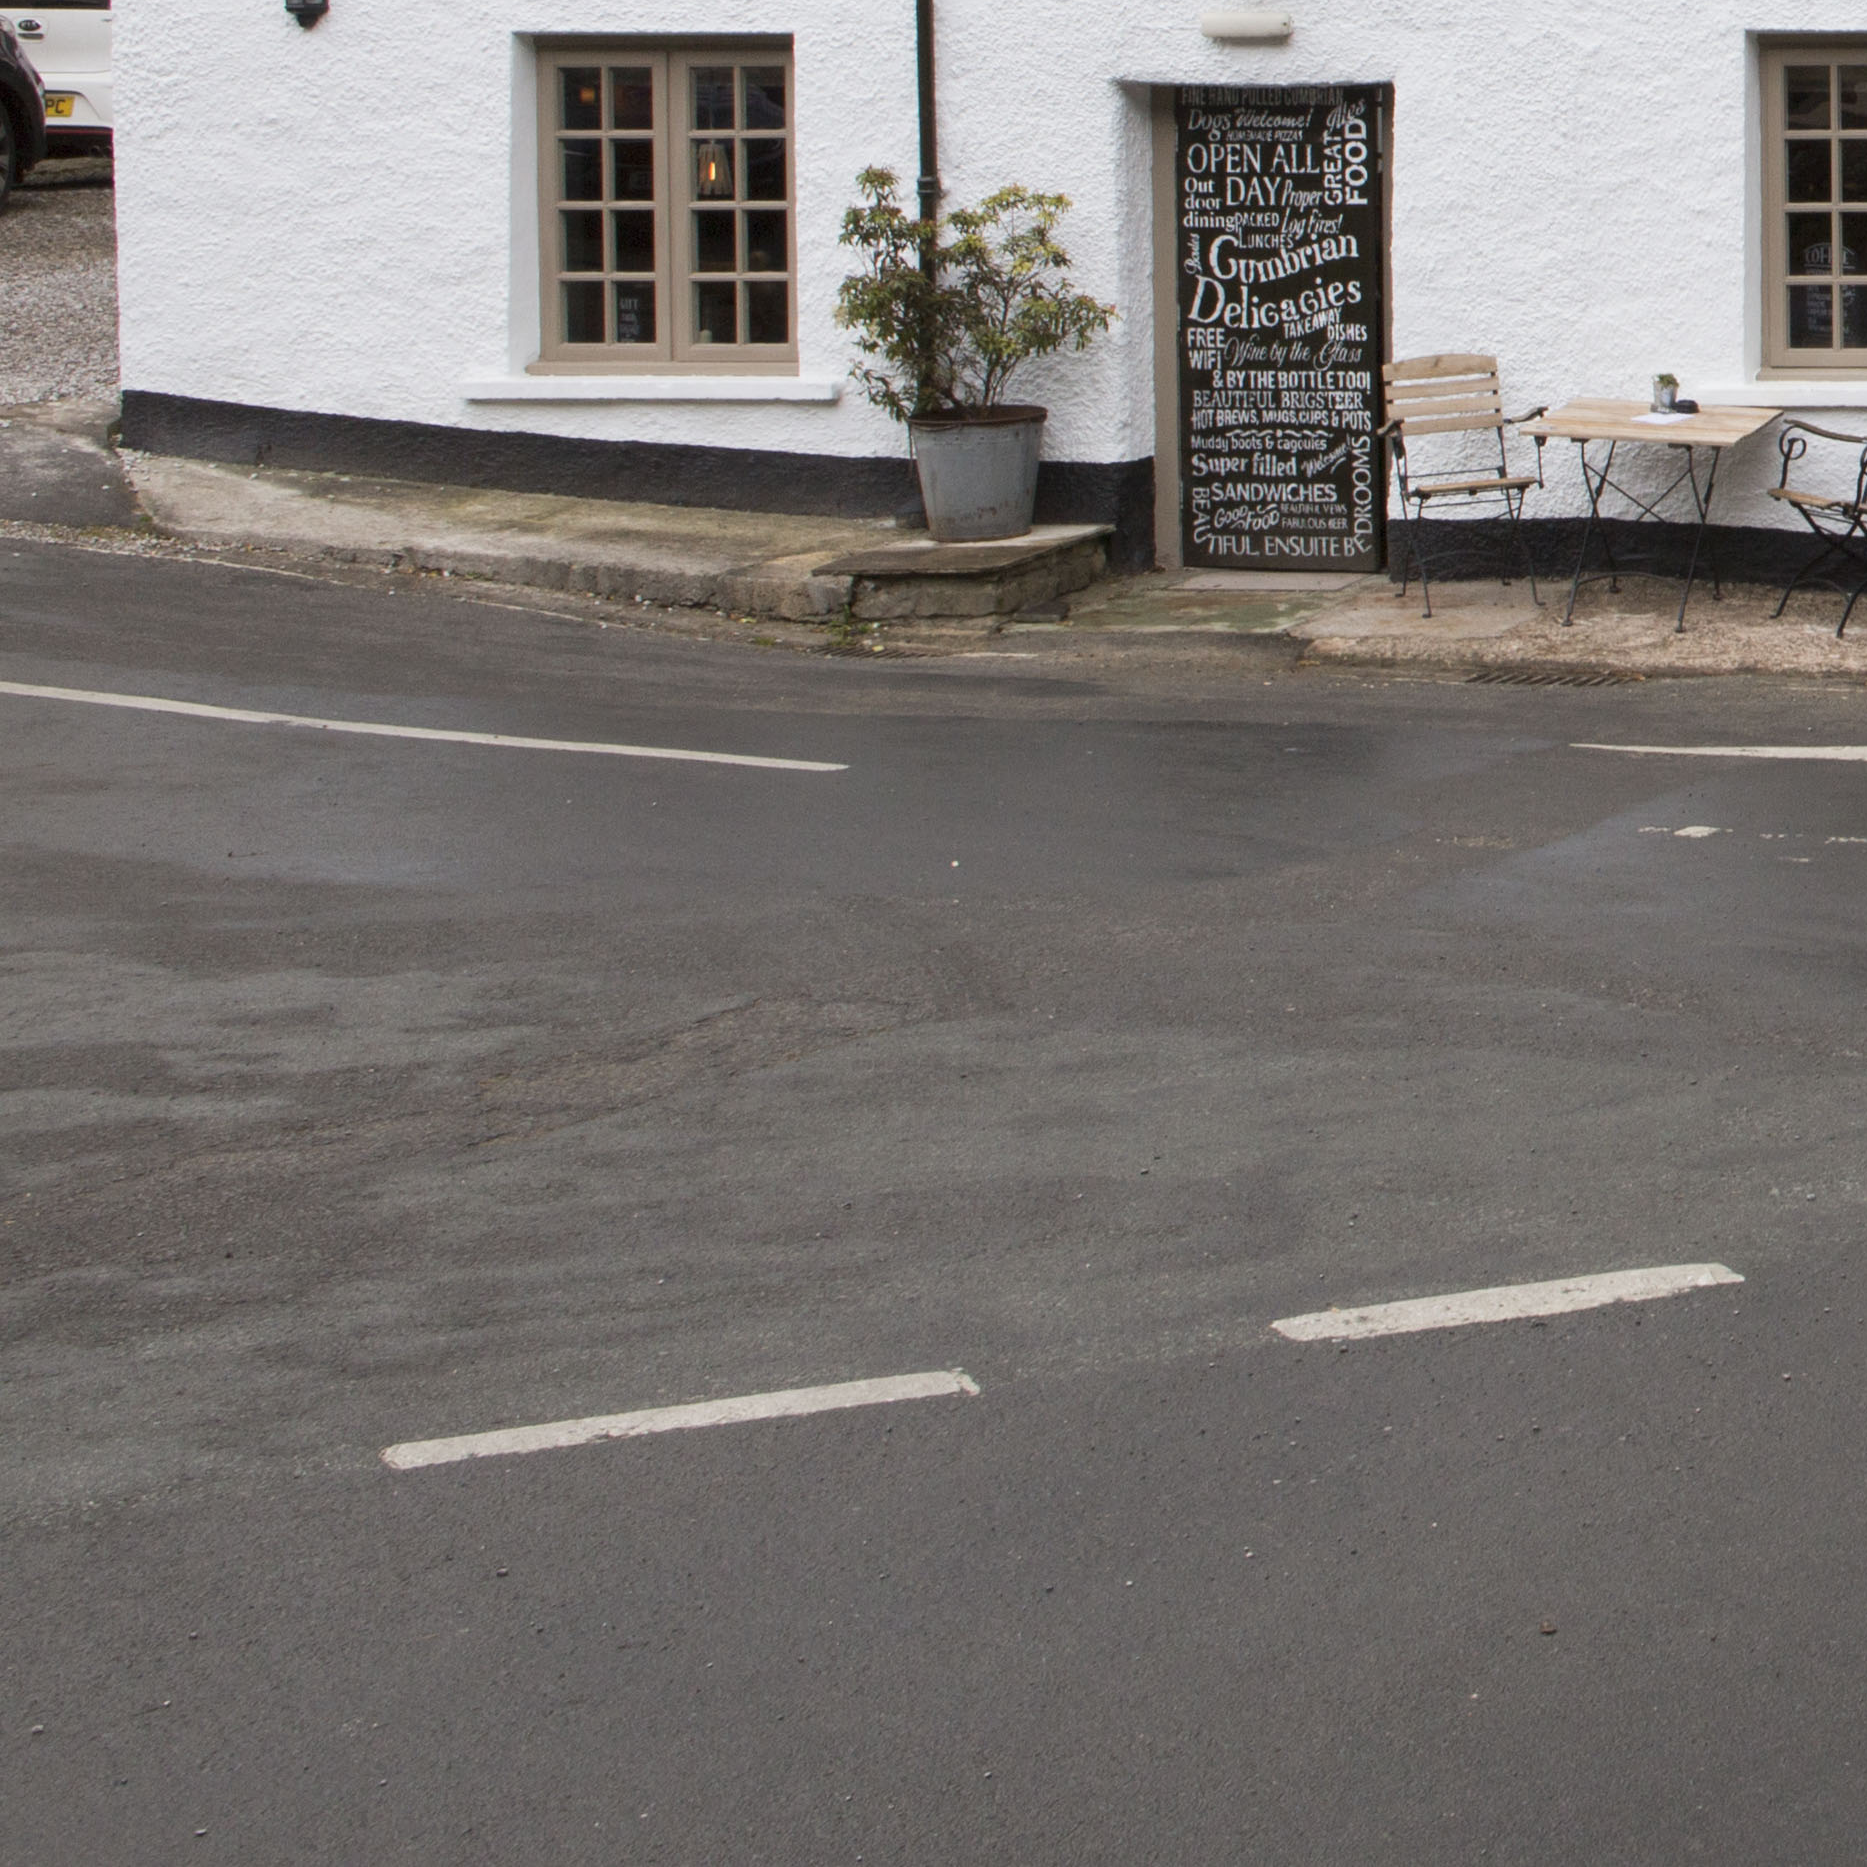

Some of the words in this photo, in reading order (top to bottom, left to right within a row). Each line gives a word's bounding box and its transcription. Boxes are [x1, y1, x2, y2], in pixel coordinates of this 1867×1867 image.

[1188, 109, 1231, 141] Dogs
[1187, 143, 1261, 173] OPEN
[1270, 143, 1321, 173] ALL
[1323, 131, 1342, 205] GREAT
[1344, 118, 1368, 205] FOOD
[1184, 177, 1215, 194] Out
[1226, 176, 1281, 206] DAY
[1281, 180, 1323, 213] Proper
[1184, 194, 1222, 210] door
[1183, 211, 1236, 231] dining
[1235, 212, 1280, 231] PACKED
[1281, 207, 1306, 240] Log
[1238, 228, 1294, 248] LUNCHES
[1209, 234, 1359, 283] Cumbrian
[1283, 307, 1342, 339] TAKEAWAY
[1327, 324, 1367, 341] DISHES
[1187, 328, 1225, 348] FREE
[1189, 350, 1222, 369] WIFI
[1224, 334, 1267, 367] Wine
[1270, 340, 1288, 367] by
[1290, 341, 1311, 360] the
[1212, 371, 1224, 389] &
[1226, 371, 1246, 389] BY
[1249, 371, 1276, 389] THE
[1278, 371, 1335, 389] BOTTLE
[1337, 371, 1371, 394] TOO!
[1192, 390, 1276, 409] BEAUTIFUL
[1281, 391, 1364, 410] BRIGSTEER
[1191, 409, 1214, 430] HOT
[1331, 411, 1339, 427] &
[1342, 411, 1371, 432] POTS
[1191, 435, 1229, 452] Muddy
[1231, 435, 1262, 450] boots
[1265, 435, 1274, 450] &
[1191, 453, 1249, 478] Super
[1252, 452, 1298, 477] filled
[1211, 483, 1338, 502] SANDWICHES
[1264, 535, 1341, 557] ENSUITE
